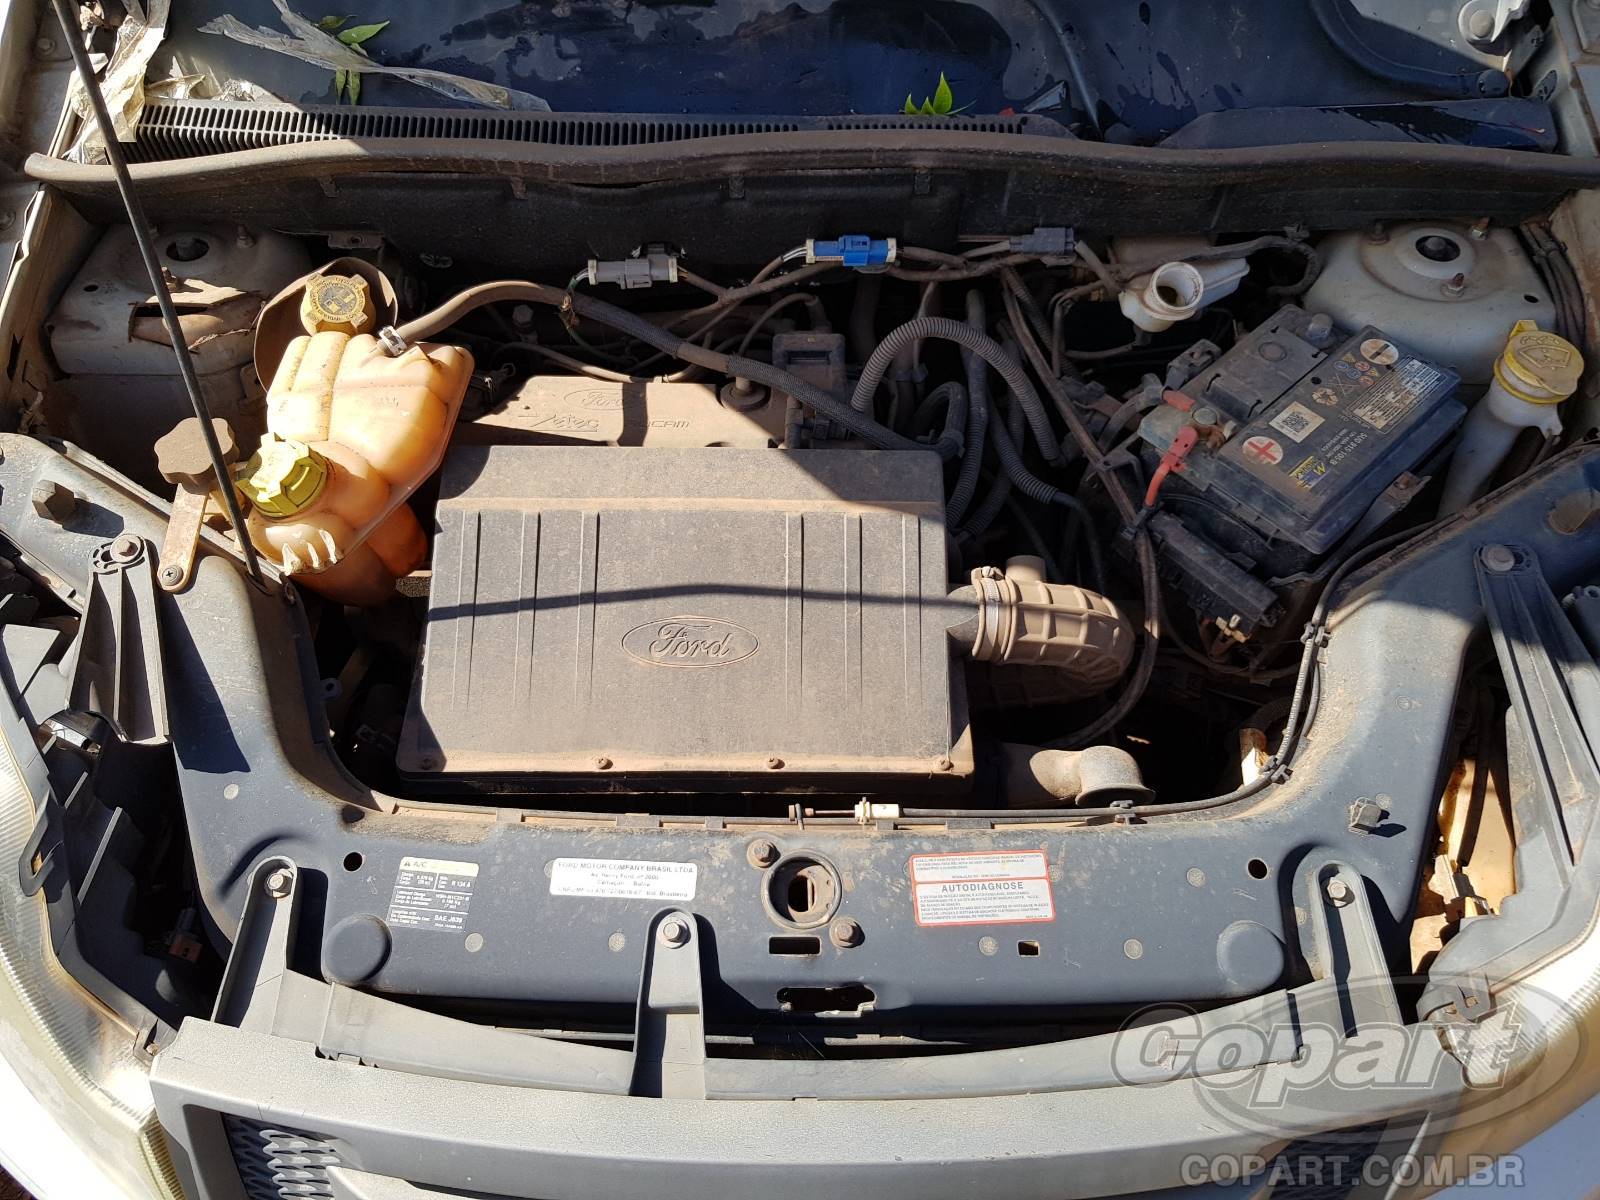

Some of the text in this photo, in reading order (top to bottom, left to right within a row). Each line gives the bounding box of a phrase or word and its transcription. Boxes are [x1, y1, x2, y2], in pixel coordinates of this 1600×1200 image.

[649, 622, 733, 658] Ford
[608, 863, 644, 871] COMPANY
[646, 865, 672, 873] BRASIL
[942, 881, 1024, 893] AUTODIAGNOSE
